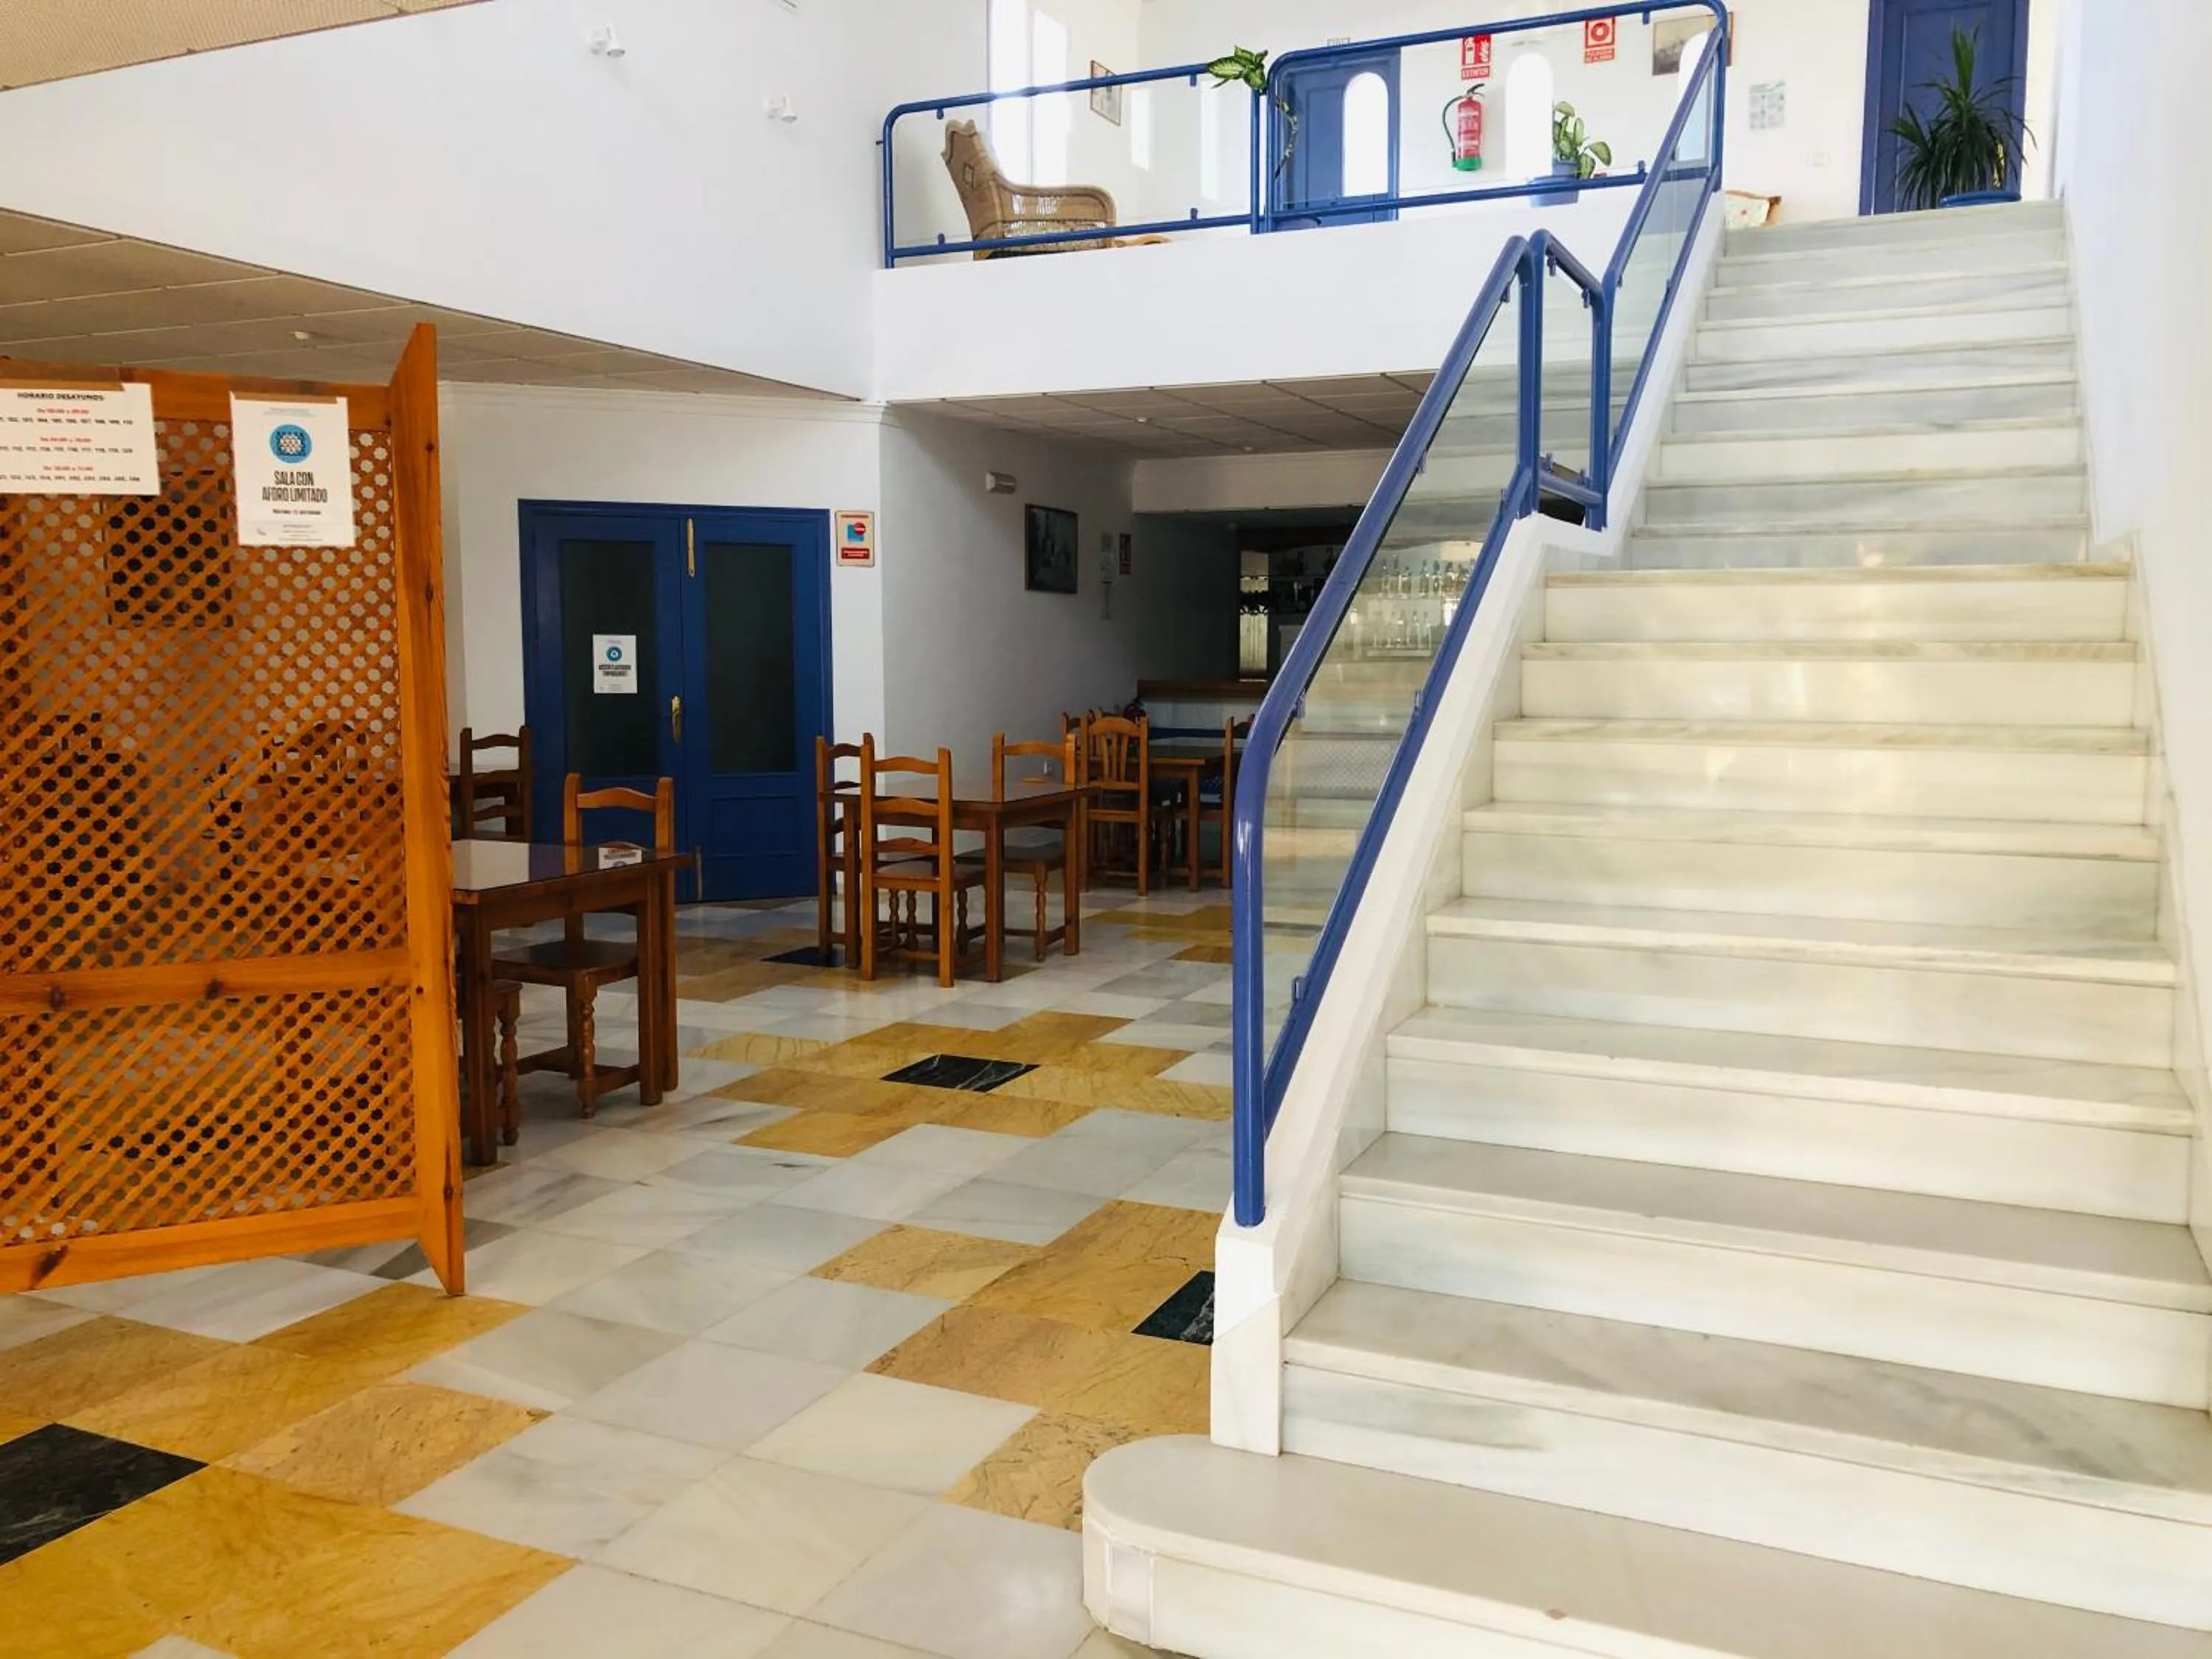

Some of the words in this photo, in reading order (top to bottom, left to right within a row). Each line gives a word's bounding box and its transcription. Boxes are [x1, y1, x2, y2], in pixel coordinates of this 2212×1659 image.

[56, 393, 105, 401] DESAYUNOS
[274, 470, 295, 486] SALA
[296, 471, 314, 486] CON
[262, 487, 289, 501] AFORO
[290, 487, 328, 503] LIMITADO
